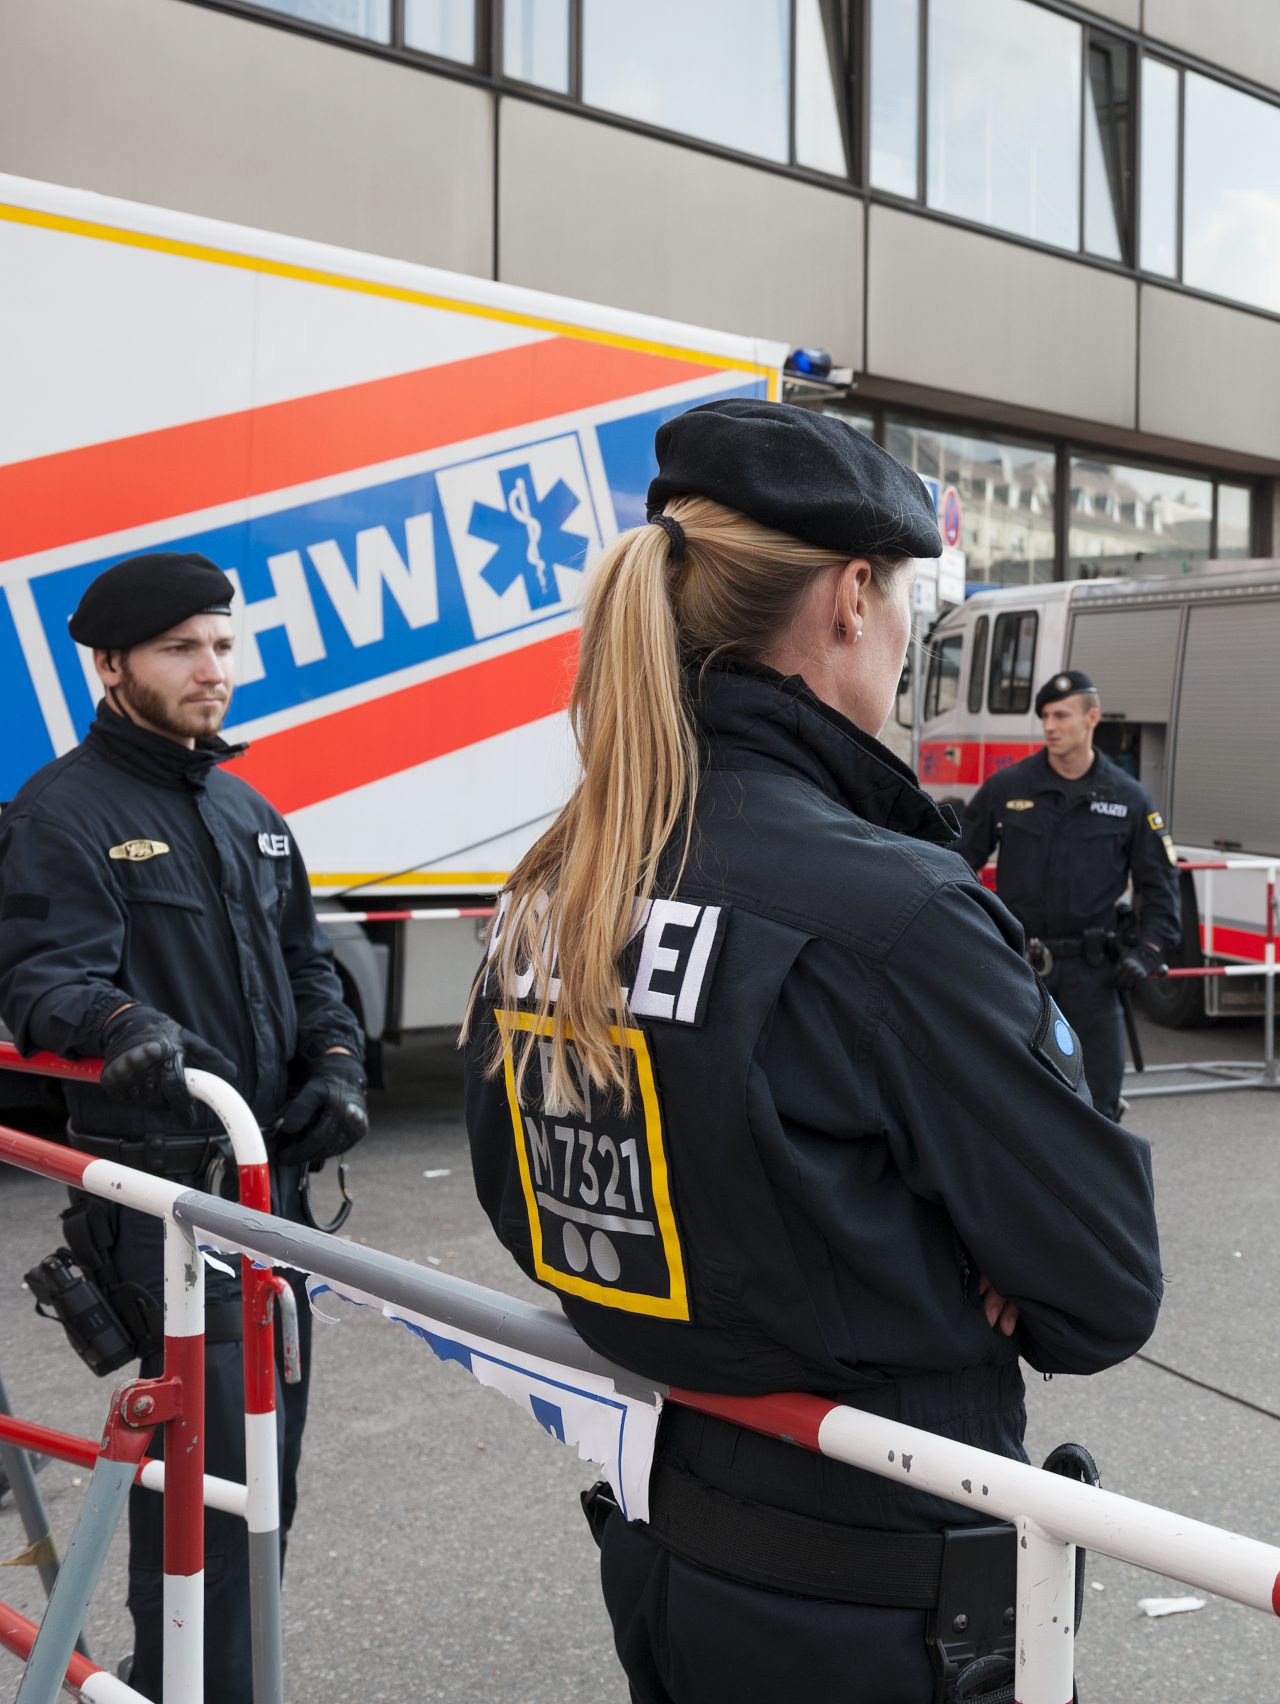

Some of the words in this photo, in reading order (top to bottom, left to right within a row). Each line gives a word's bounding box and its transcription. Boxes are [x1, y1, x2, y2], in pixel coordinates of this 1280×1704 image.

[1090, 801, 1128, 818] POLIZEI
[524, 1116, 554, 1191] M
[554, 1125, 644, 1213] 7321
